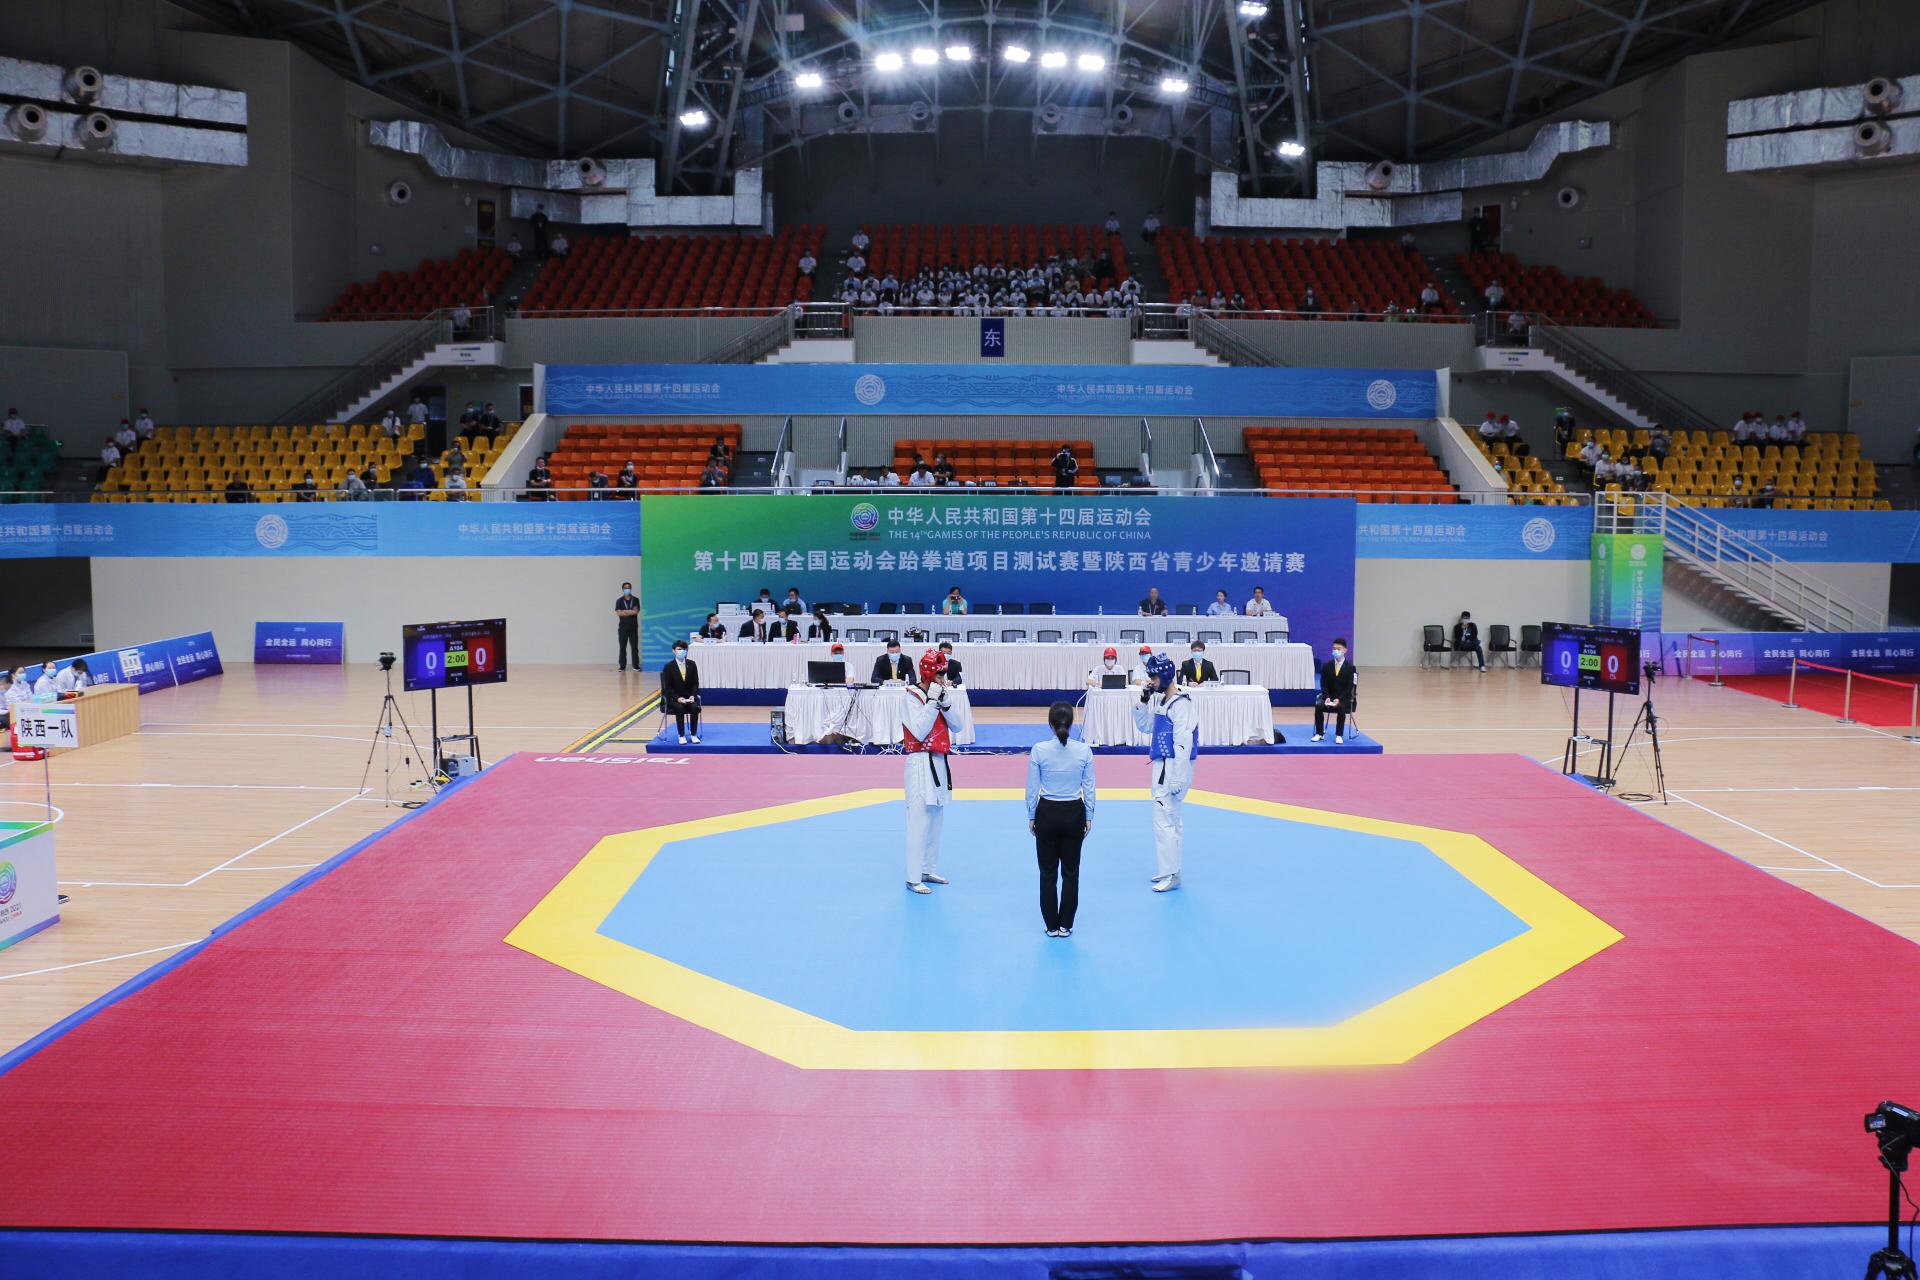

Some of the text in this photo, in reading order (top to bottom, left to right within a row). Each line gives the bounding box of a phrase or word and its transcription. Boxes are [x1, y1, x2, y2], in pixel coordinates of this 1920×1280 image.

[984, 328, 1001, 347] 东
[585, 383, 721, 394] 中华人民共和国第十四届运动会
[1056, 384, 1193, 395] 中华人民共和国第十四届运动会
[888, 507, 1152, 526] 中华人民共和国第十四届运动会
[458, 523, 612, 535] 中华人民共和国第十四届运动会
[888, 531, 908, 539] THE
[965, 531, 978, 539] OF
[982, 531, 1000, 539] THE
[1002, 531, 1050, 539] PEOPLE'S
[1052, 531, 1102, 539] REPUBLIC
[1104, 531, 1118, 539] OF
[1119, 531, 1151, 540] CHINA
[693, 550, 1306, 573] 第十四届全国运动会跆拳道项目测试赛暨陕西省青少年邀请赛
[425, 651, 437, 670] 0
[447, 654, 466, 664] 2:00
[475, 647, 487, 666] 0
[1561, 650, 1572, 669] 0
[1580, 657, 1599, 667] 2:00
[1607, 655, 1619, 673] 0
[20, 718, 74, 738] 陕西一队
